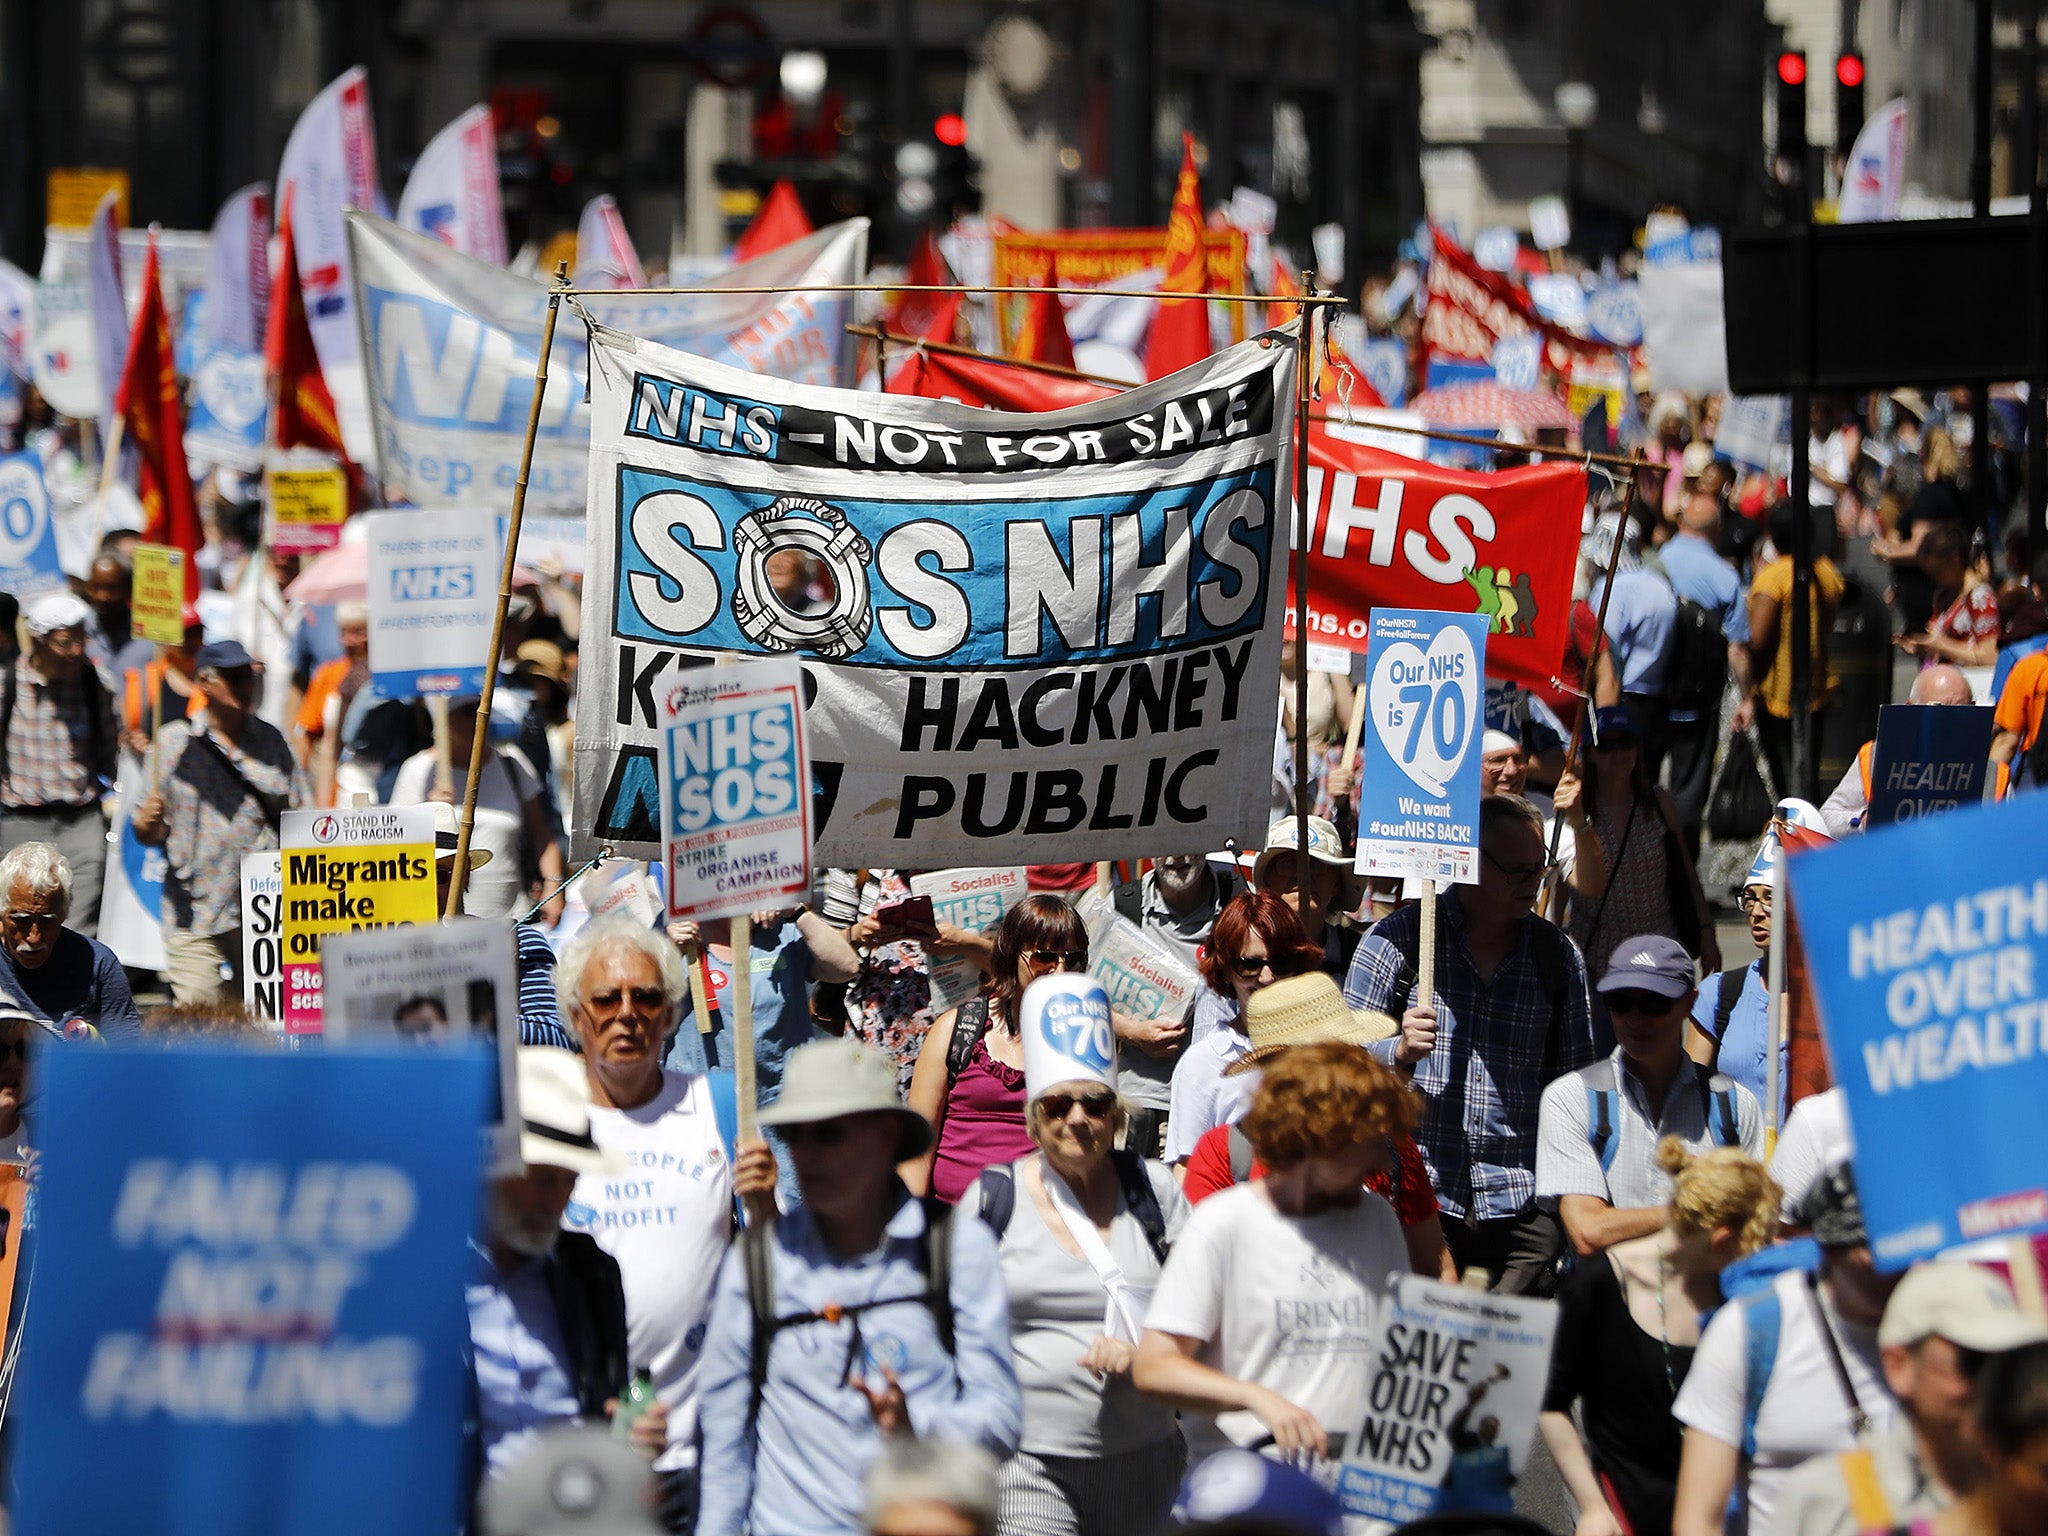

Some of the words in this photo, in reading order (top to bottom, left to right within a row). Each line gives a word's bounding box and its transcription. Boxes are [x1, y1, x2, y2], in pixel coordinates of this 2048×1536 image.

[636, 382, 776, 454] NHS
[986, 430, 1106, 466] FOR
[1125, 383, 1248, 454] SALE
[394, 566, 472, 602] NHS
[1003, 488, 1269, 660] NHS
[1375, 628, 1430, 640] #Free4allForever
[1376, 618, 1416, 629] #OurNHS70
[1390, 660, 1424, 684] Our
[1428, 653, 1465, 681] NHS
[899, 639, 1256, 752] HACKNEY
[1388, 703, 1403, 727] is
[1399, 680, 1466, 763] 70
[673, 706, 791, 781] NHS
[893, 749, 1219, 840] PUBLIC
[1887, 762, 1975, 791] HEALTH
[677, 760, 793, 832] SOS
[1398, 797, 1420, 815] We
[1423, 803, 1451, 818] want
[343, 817, 378, 828] STAND
[382, 815, 398, 827] UP
[343, 829, 357, 841] TO
[361, 827, 404, 840] RACISM
[1370, 821, 1435, 840] #ourNHS
[1437, 824, 1471, 843] BACK!
[289, 853, 428, 892] Migrants
[675, 845, 728, 869] STRIKE
[698, 852, 779, 880] ORGANISE
[716, 863, 802, 893] CAMPAIGN
[950, 871, 1017, 893] Socialist
[290, 891, 375, 921] make
[1849, 879, 2048, 980] HEALTH
[1099, 964, 1159, 1018] NHS
[1129, 957, 1184, 998] Socialist
[1886, 944, 2034, 1029] OVER
[958, 1022, 977, 1032] Jeep
[1048, 1002, 1079, 1019] Our
[1082, 1000, 1109, 1019] NHS
[1051, 1020, 1066, 1036] is
[1068, 1017, 1113, 1061] 70
[1862, 998, 2048, 1096] WEALT
[605, 1180, 655, 1201] NOT
[1379, 1323, 1478, 1385] SAVE
[1370, 1370, 1450, 1428] OUR
[1356, 1416, 1437, 1473] NHS
